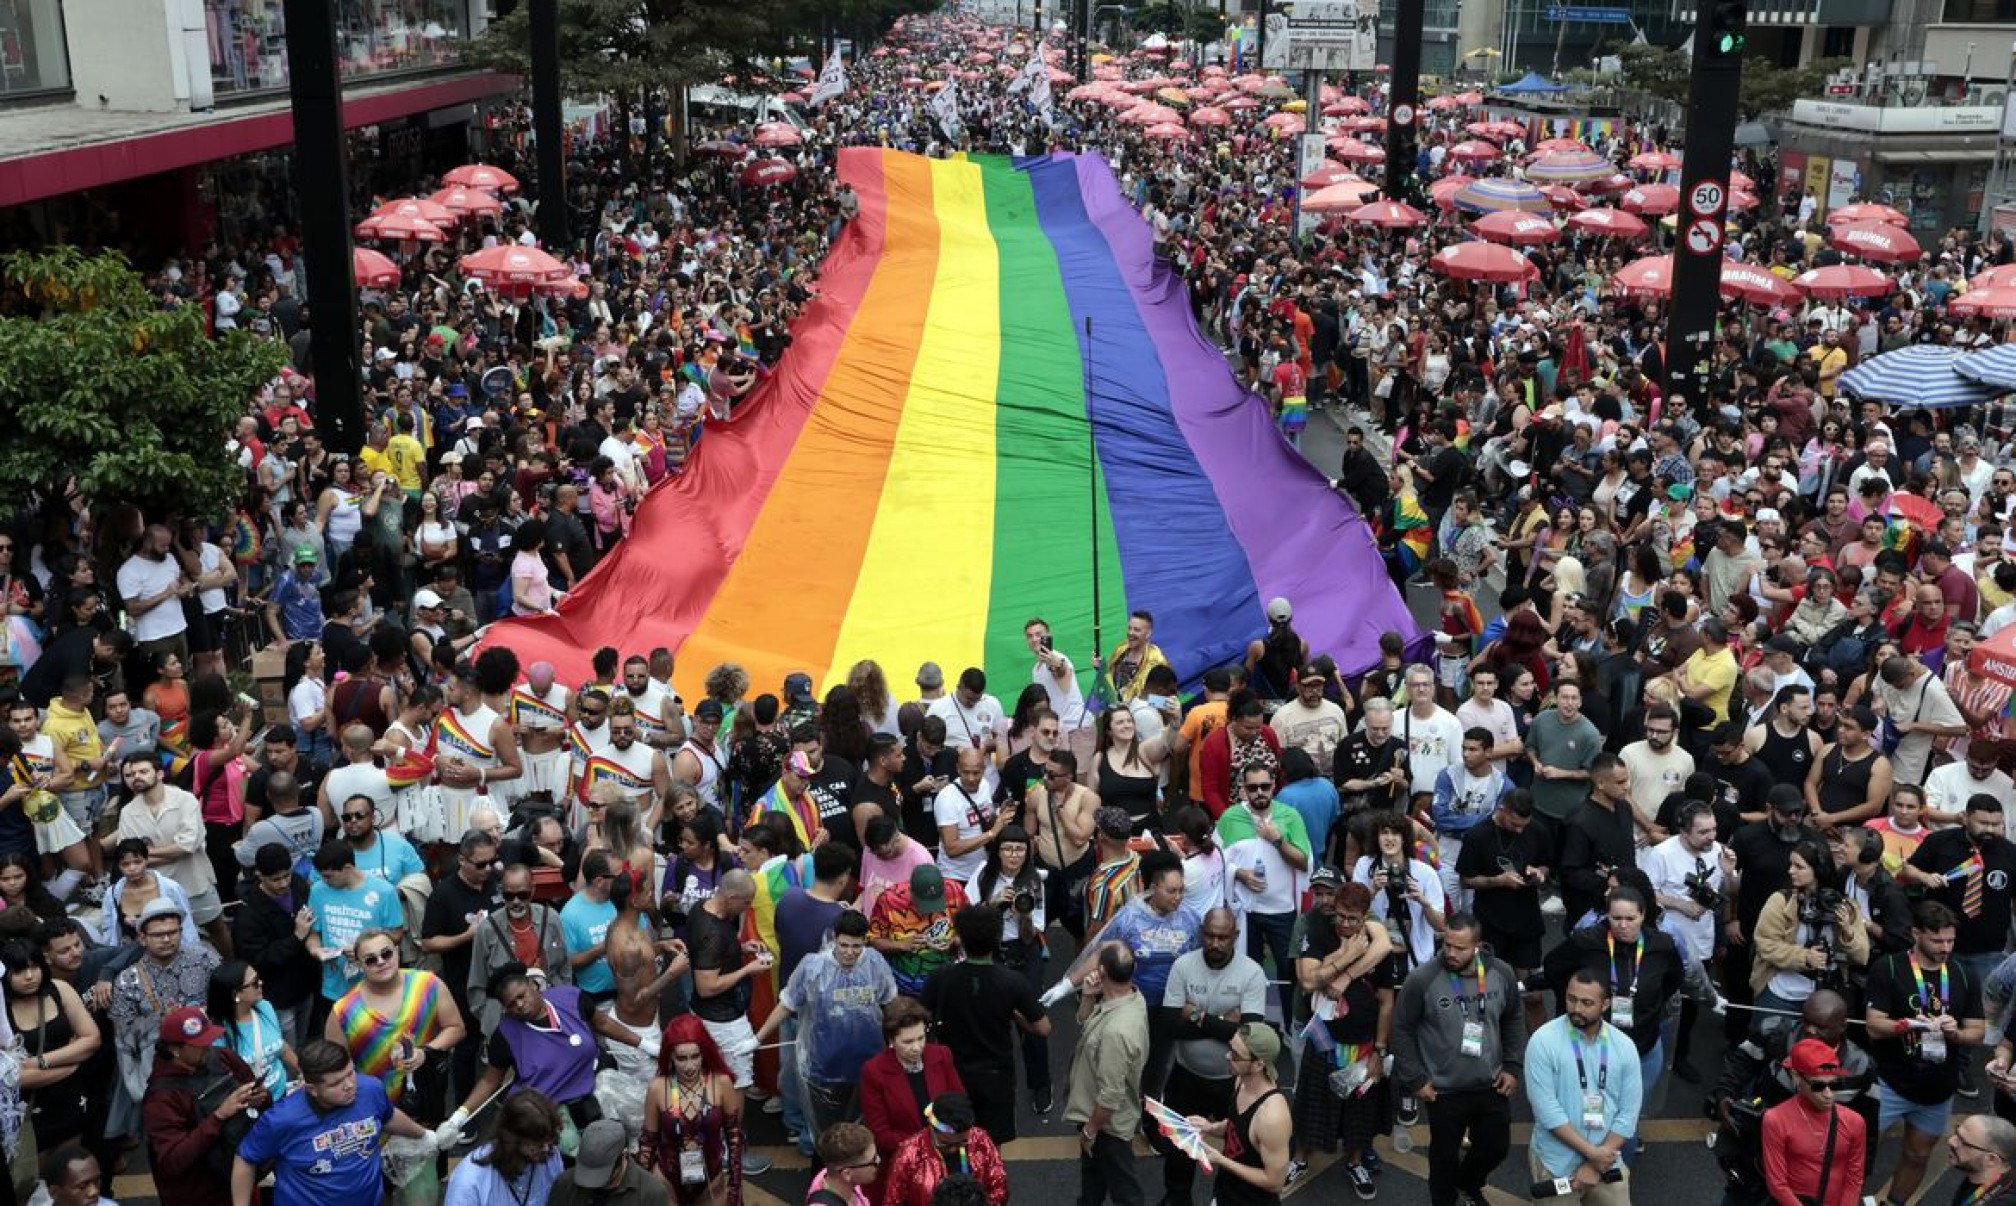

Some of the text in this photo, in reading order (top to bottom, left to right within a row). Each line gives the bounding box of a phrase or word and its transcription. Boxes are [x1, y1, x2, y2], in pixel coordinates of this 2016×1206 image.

[1696, 188, 1720, 204] 50
[1847, 231, 1891, 249] BRAHMA
[1721, 270, 1774, 291] BRAHMA
[1983, 658, 2016, 680] AMSTE
